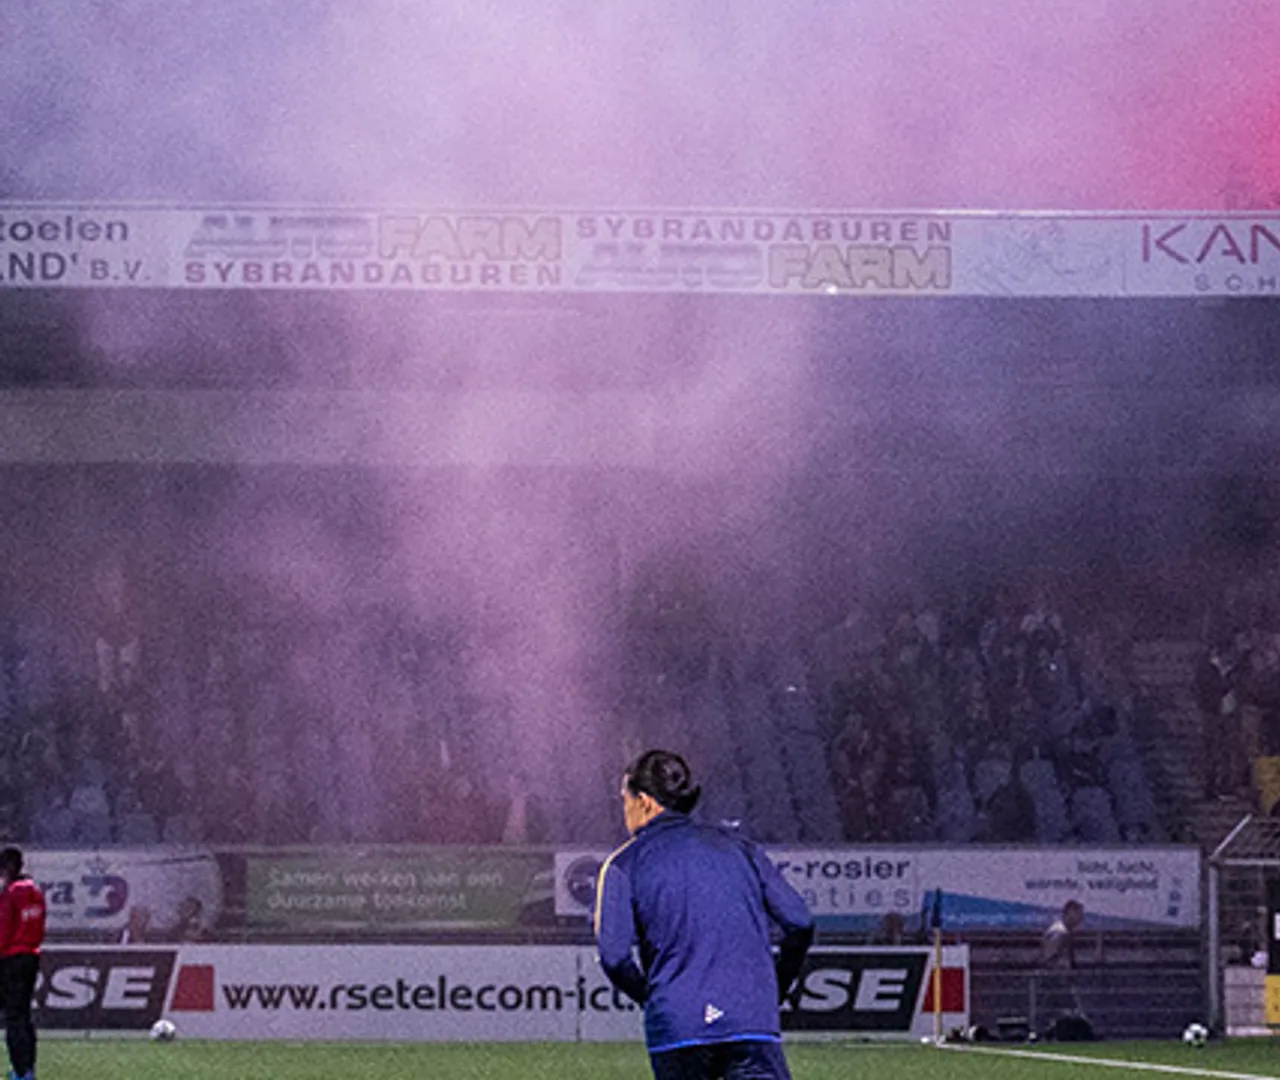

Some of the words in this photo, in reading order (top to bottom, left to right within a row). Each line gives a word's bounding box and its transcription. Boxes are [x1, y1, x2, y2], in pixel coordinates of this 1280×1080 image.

[0, 216, 128, 241] oelen
[378, 216, 562, 260] FARM
[576, 219, 951, 241] SYBRANDABUREN
[0, 252, 78, 280] ND'
[184, 261, 561, 285] SYBRANDABUREN
[767, 245, 952, 289] FARM
[778, 855, 911, 880] r-rosier
[802, 886, 910, 908] aties
[221, 975, 646, 1012] www.rsetelecom-ict.
